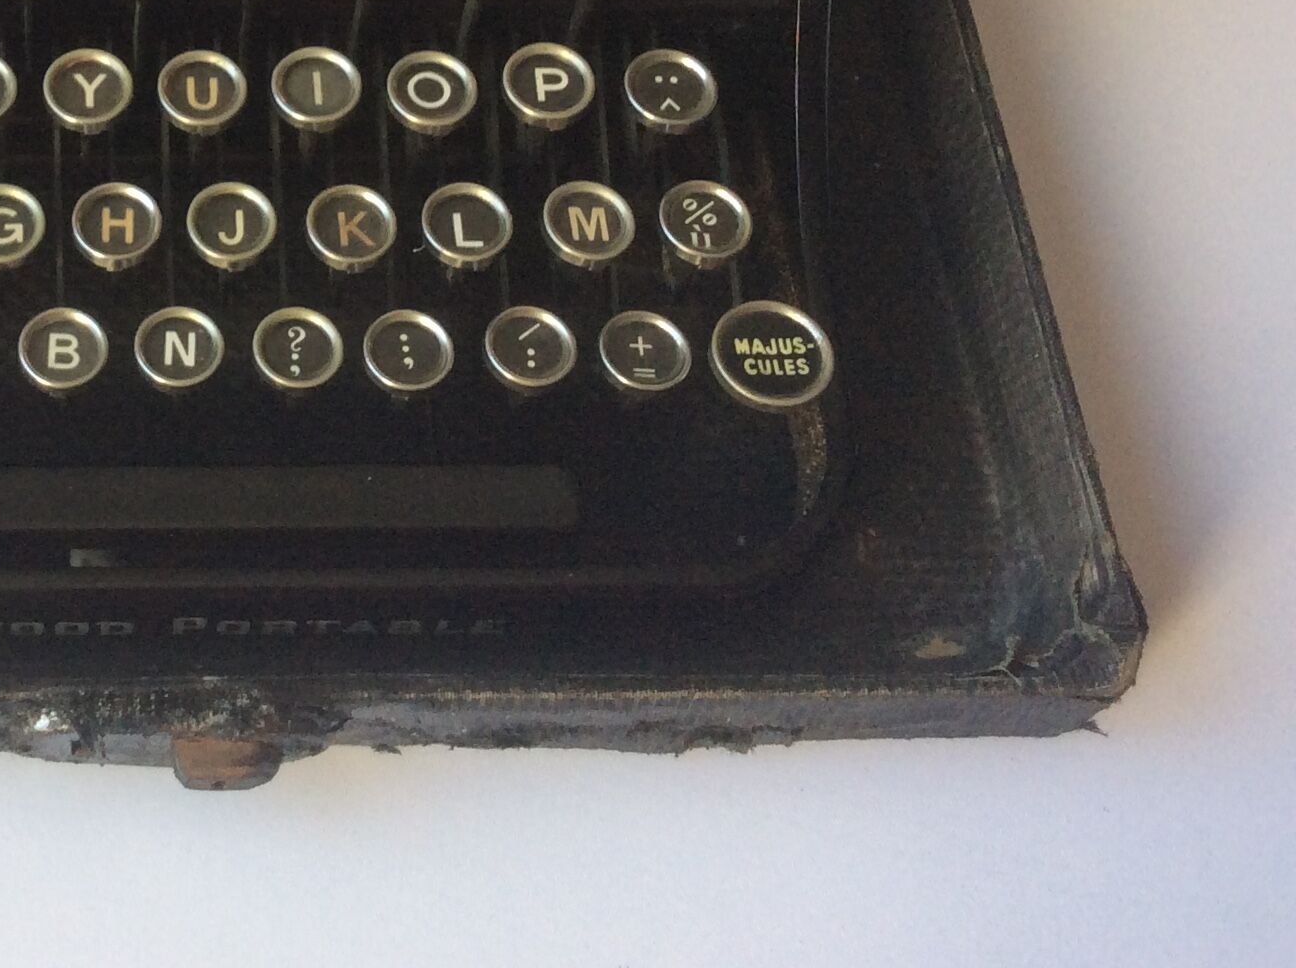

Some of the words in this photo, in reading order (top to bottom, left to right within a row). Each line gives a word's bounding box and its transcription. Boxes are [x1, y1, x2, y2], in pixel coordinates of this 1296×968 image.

[73, 73, 107, 109] Y
[186, 77, 218, 111] U
[312, 71, 323, 106] I
[407, 71, 451, 109] O
[533, 67, 569, 102] P
[101, 206, 135, 244] H
[217, 208, 245, 246] J
[337, 210, 376, 248] K
[567, 206, 611, 242] M
[683, 198, 717, 226] %
[452, 212, 484, 249] L
[47, 332, 81, 370] B
[163, 330, 196, 368] N
[287, 326, 306, 361] ?
[734, 336, 815, 356] MAJUS-
[743, 357, 811, 377] CULES
